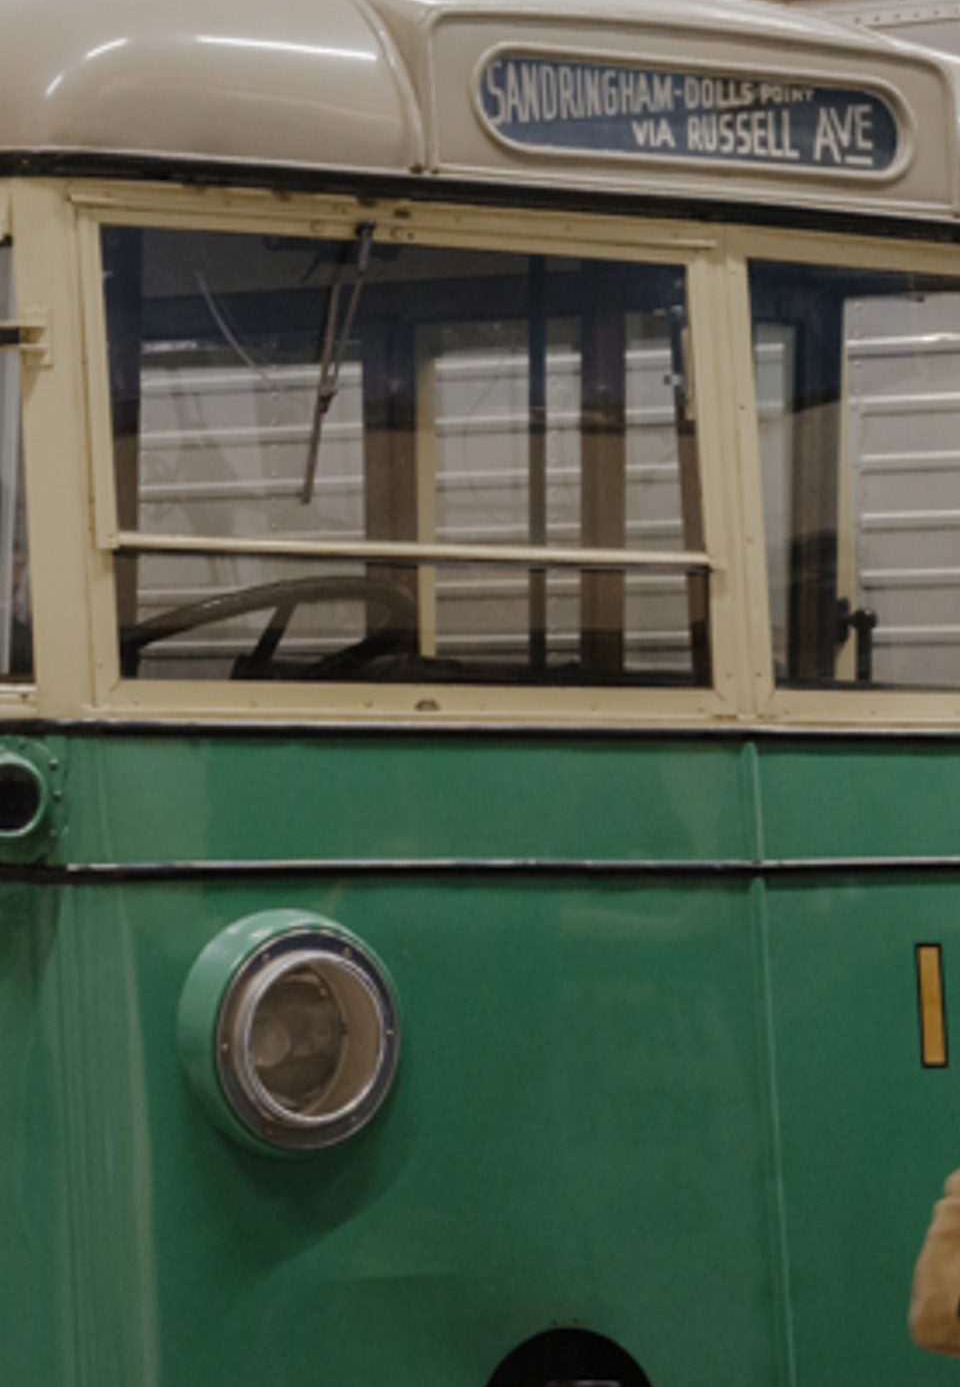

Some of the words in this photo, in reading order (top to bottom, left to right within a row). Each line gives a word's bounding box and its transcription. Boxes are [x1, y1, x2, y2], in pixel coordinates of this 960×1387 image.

[759, 83, 815, 104] POINT
[631, 117, 676, 148] VIA
[687, 109, 800, 158] RUSSELL
[812, 104, 874, 163] AVE
